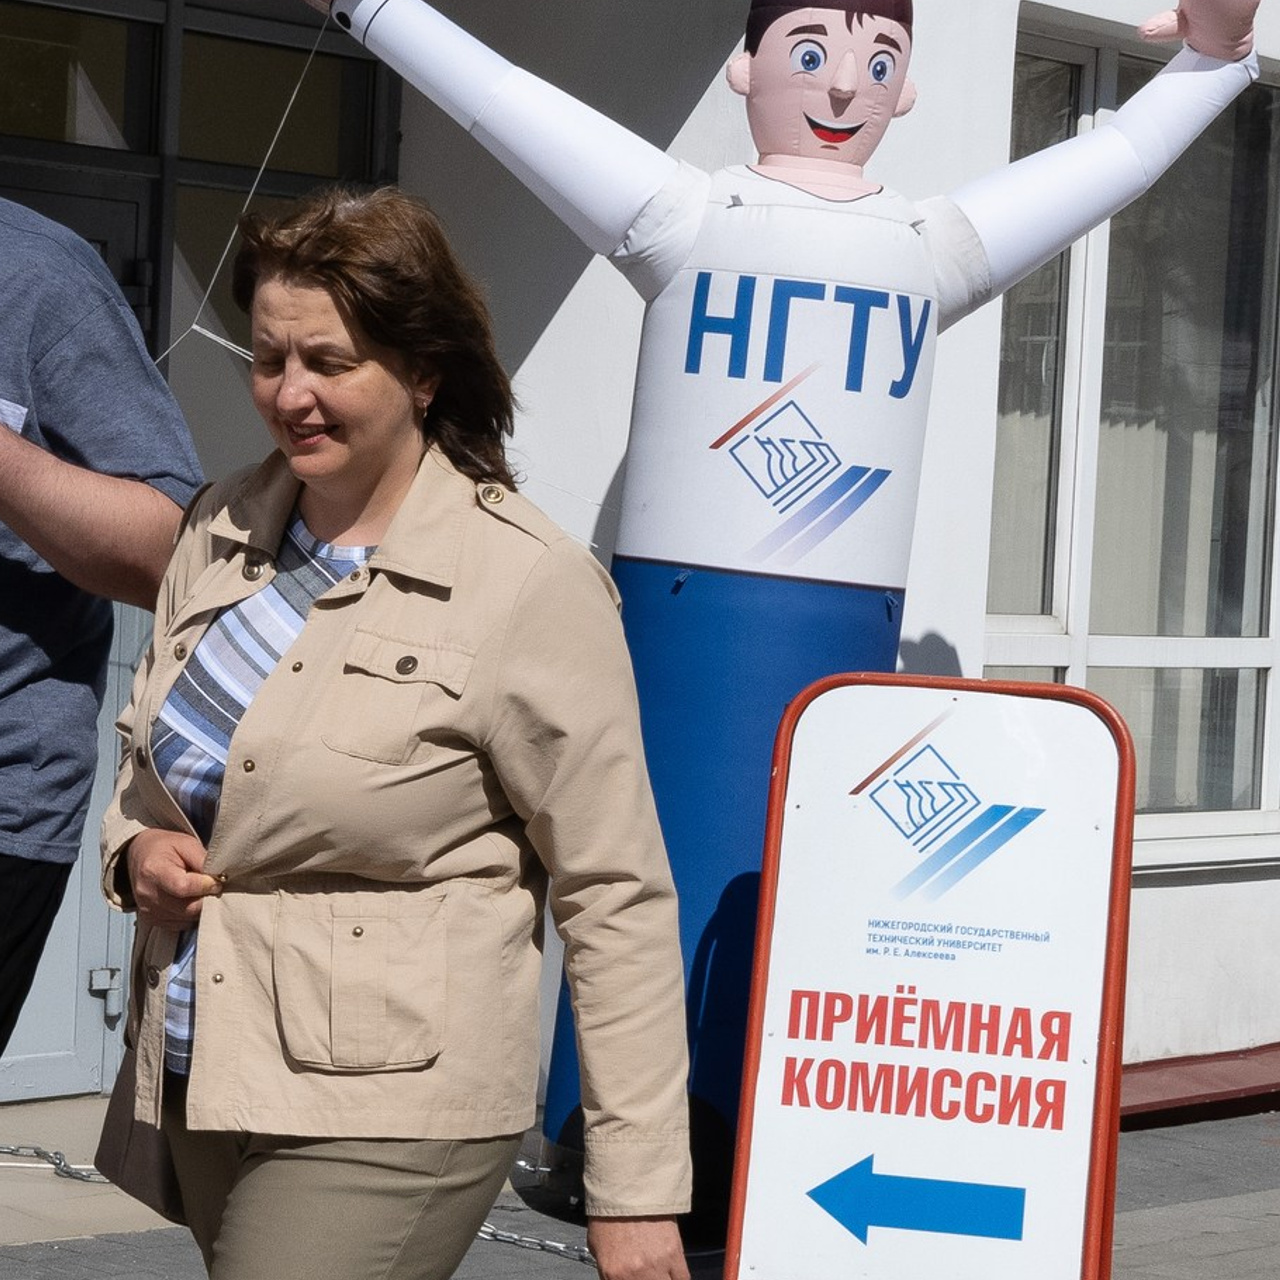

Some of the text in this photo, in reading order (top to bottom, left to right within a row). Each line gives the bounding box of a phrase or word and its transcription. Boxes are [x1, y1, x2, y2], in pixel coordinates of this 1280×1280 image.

[684, 271, 930, 399] НГТУ
[866, 946, 956, 961] им. Р. Е. Алексеева
[867, 933, 1003, 953] ТЕХНИЧЕСКИЙ УНИВЕРСИТЕТ
[868, 919, 1051, 943] НИЖЕГОРОДСКИЙ ГОСУДАРСТВЕННЫЙ
[787, 984, 1072, 1062] ПРИЁМНАЯ
[780, 1056, 1067, 1131] КОМИССИЯ
